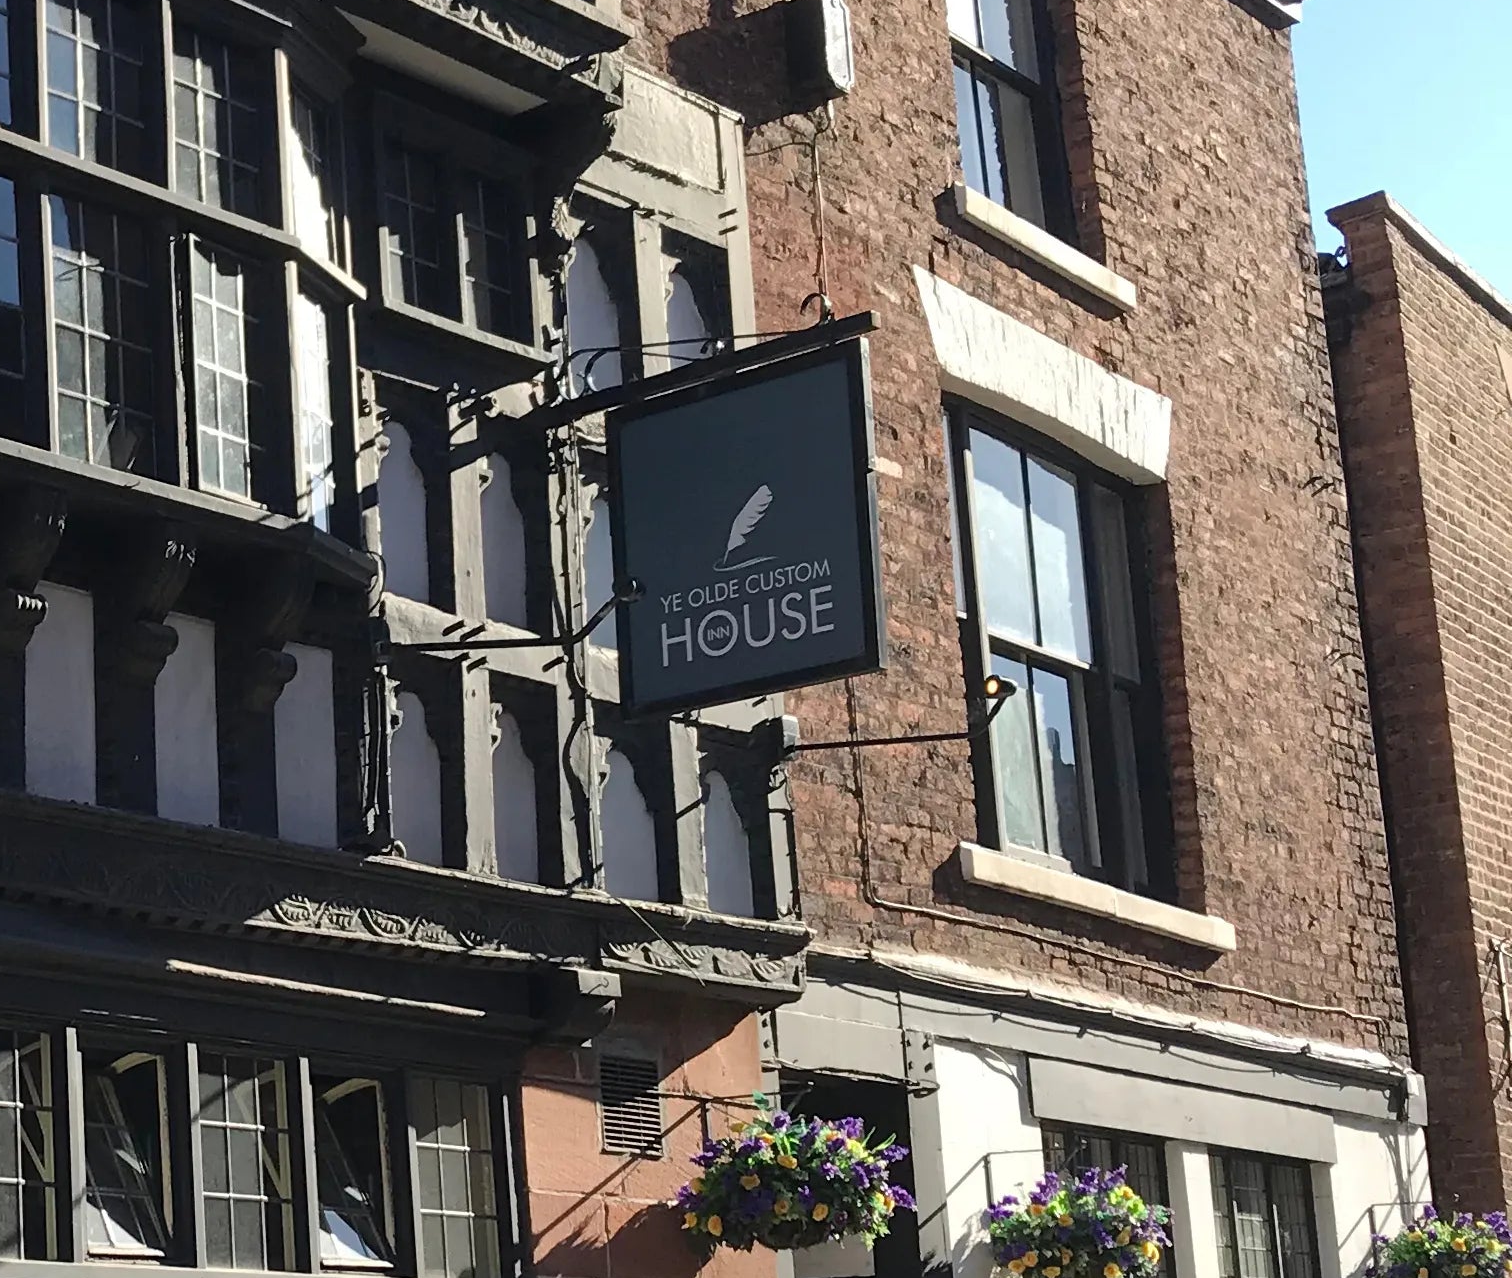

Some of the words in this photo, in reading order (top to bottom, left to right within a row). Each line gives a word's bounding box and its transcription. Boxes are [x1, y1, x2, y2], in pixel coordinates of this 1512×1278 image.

[660, 593, 682, 614] YE
[688, 582, 739, 609] OLDE
[744, 559, 831, 596] CUSTOM
[661, 584, 835, 667] HOUSE
[706, 624, 731, 642] INN
